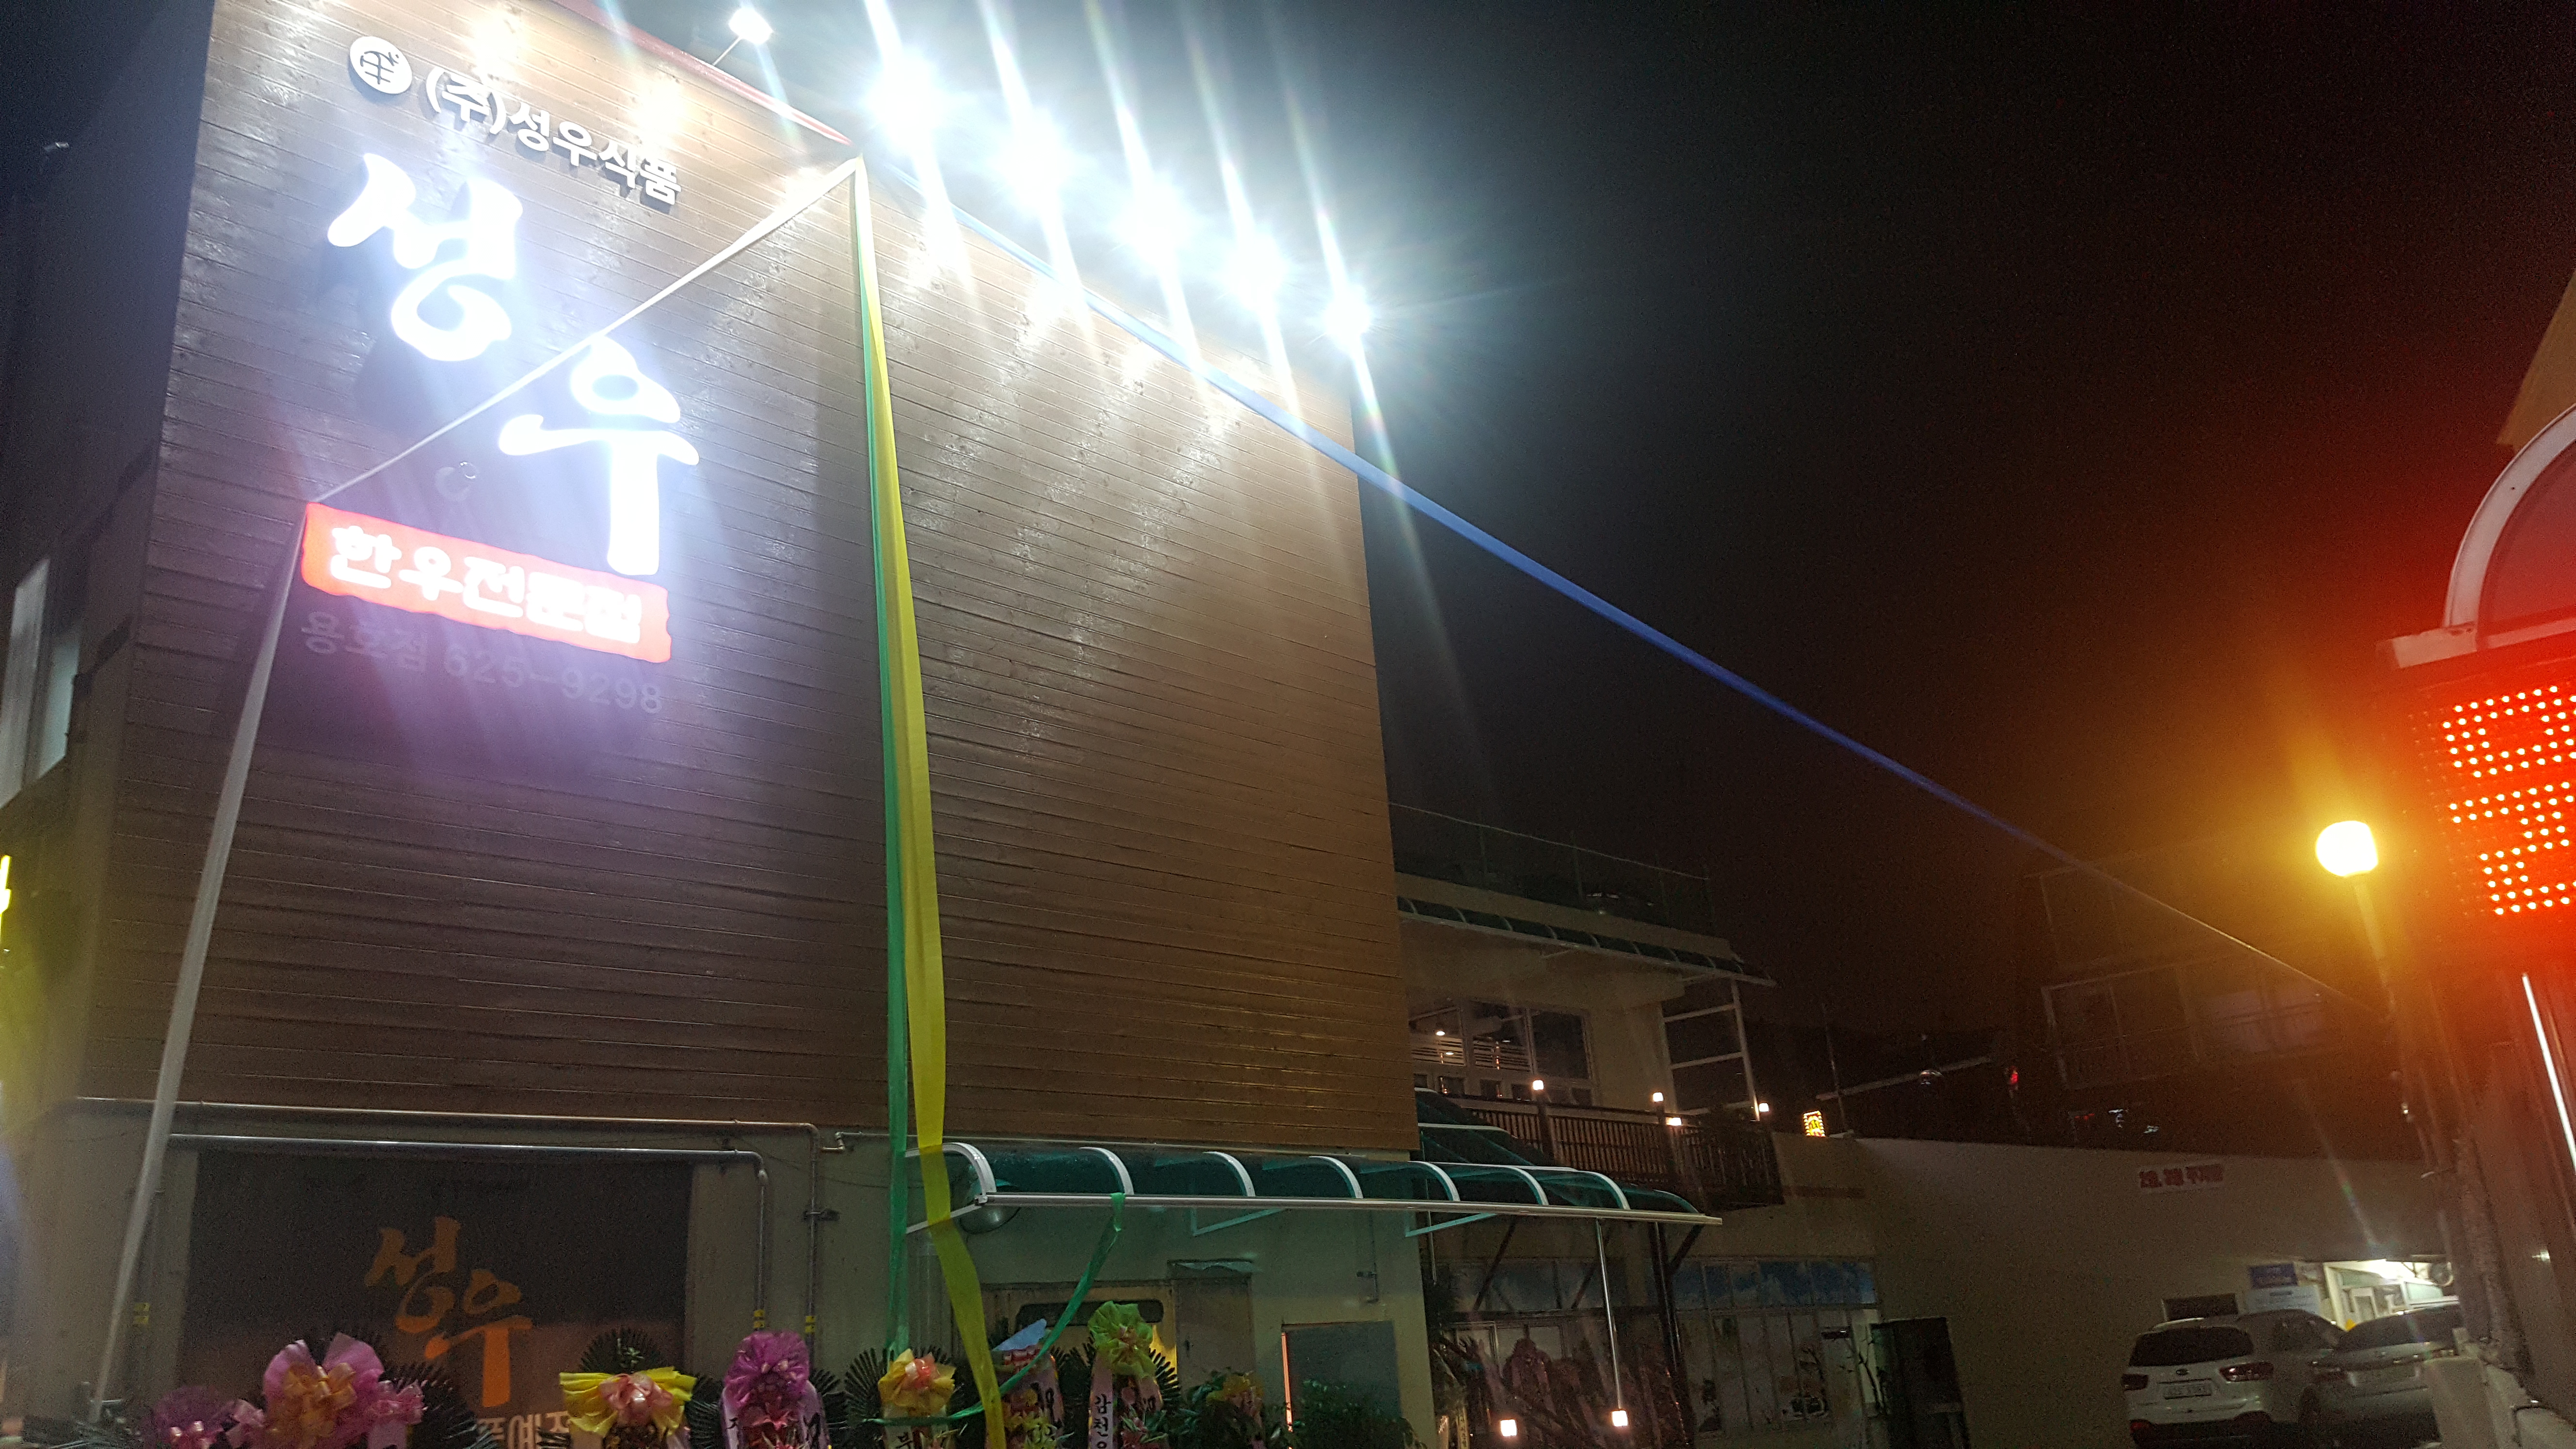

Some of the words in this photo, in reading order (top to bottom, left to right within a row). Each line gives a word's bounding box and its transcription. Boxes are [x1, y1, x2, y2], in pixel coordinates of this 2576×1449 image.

[426, 66, 681, 206] (주)성우식품
[327, 152, 700, 576] 성우
[330, 525, 643, 644] 한우전문점
[443, 643, 663, 714] 625-9298
[364, 1215, 533, 1408] 성우
